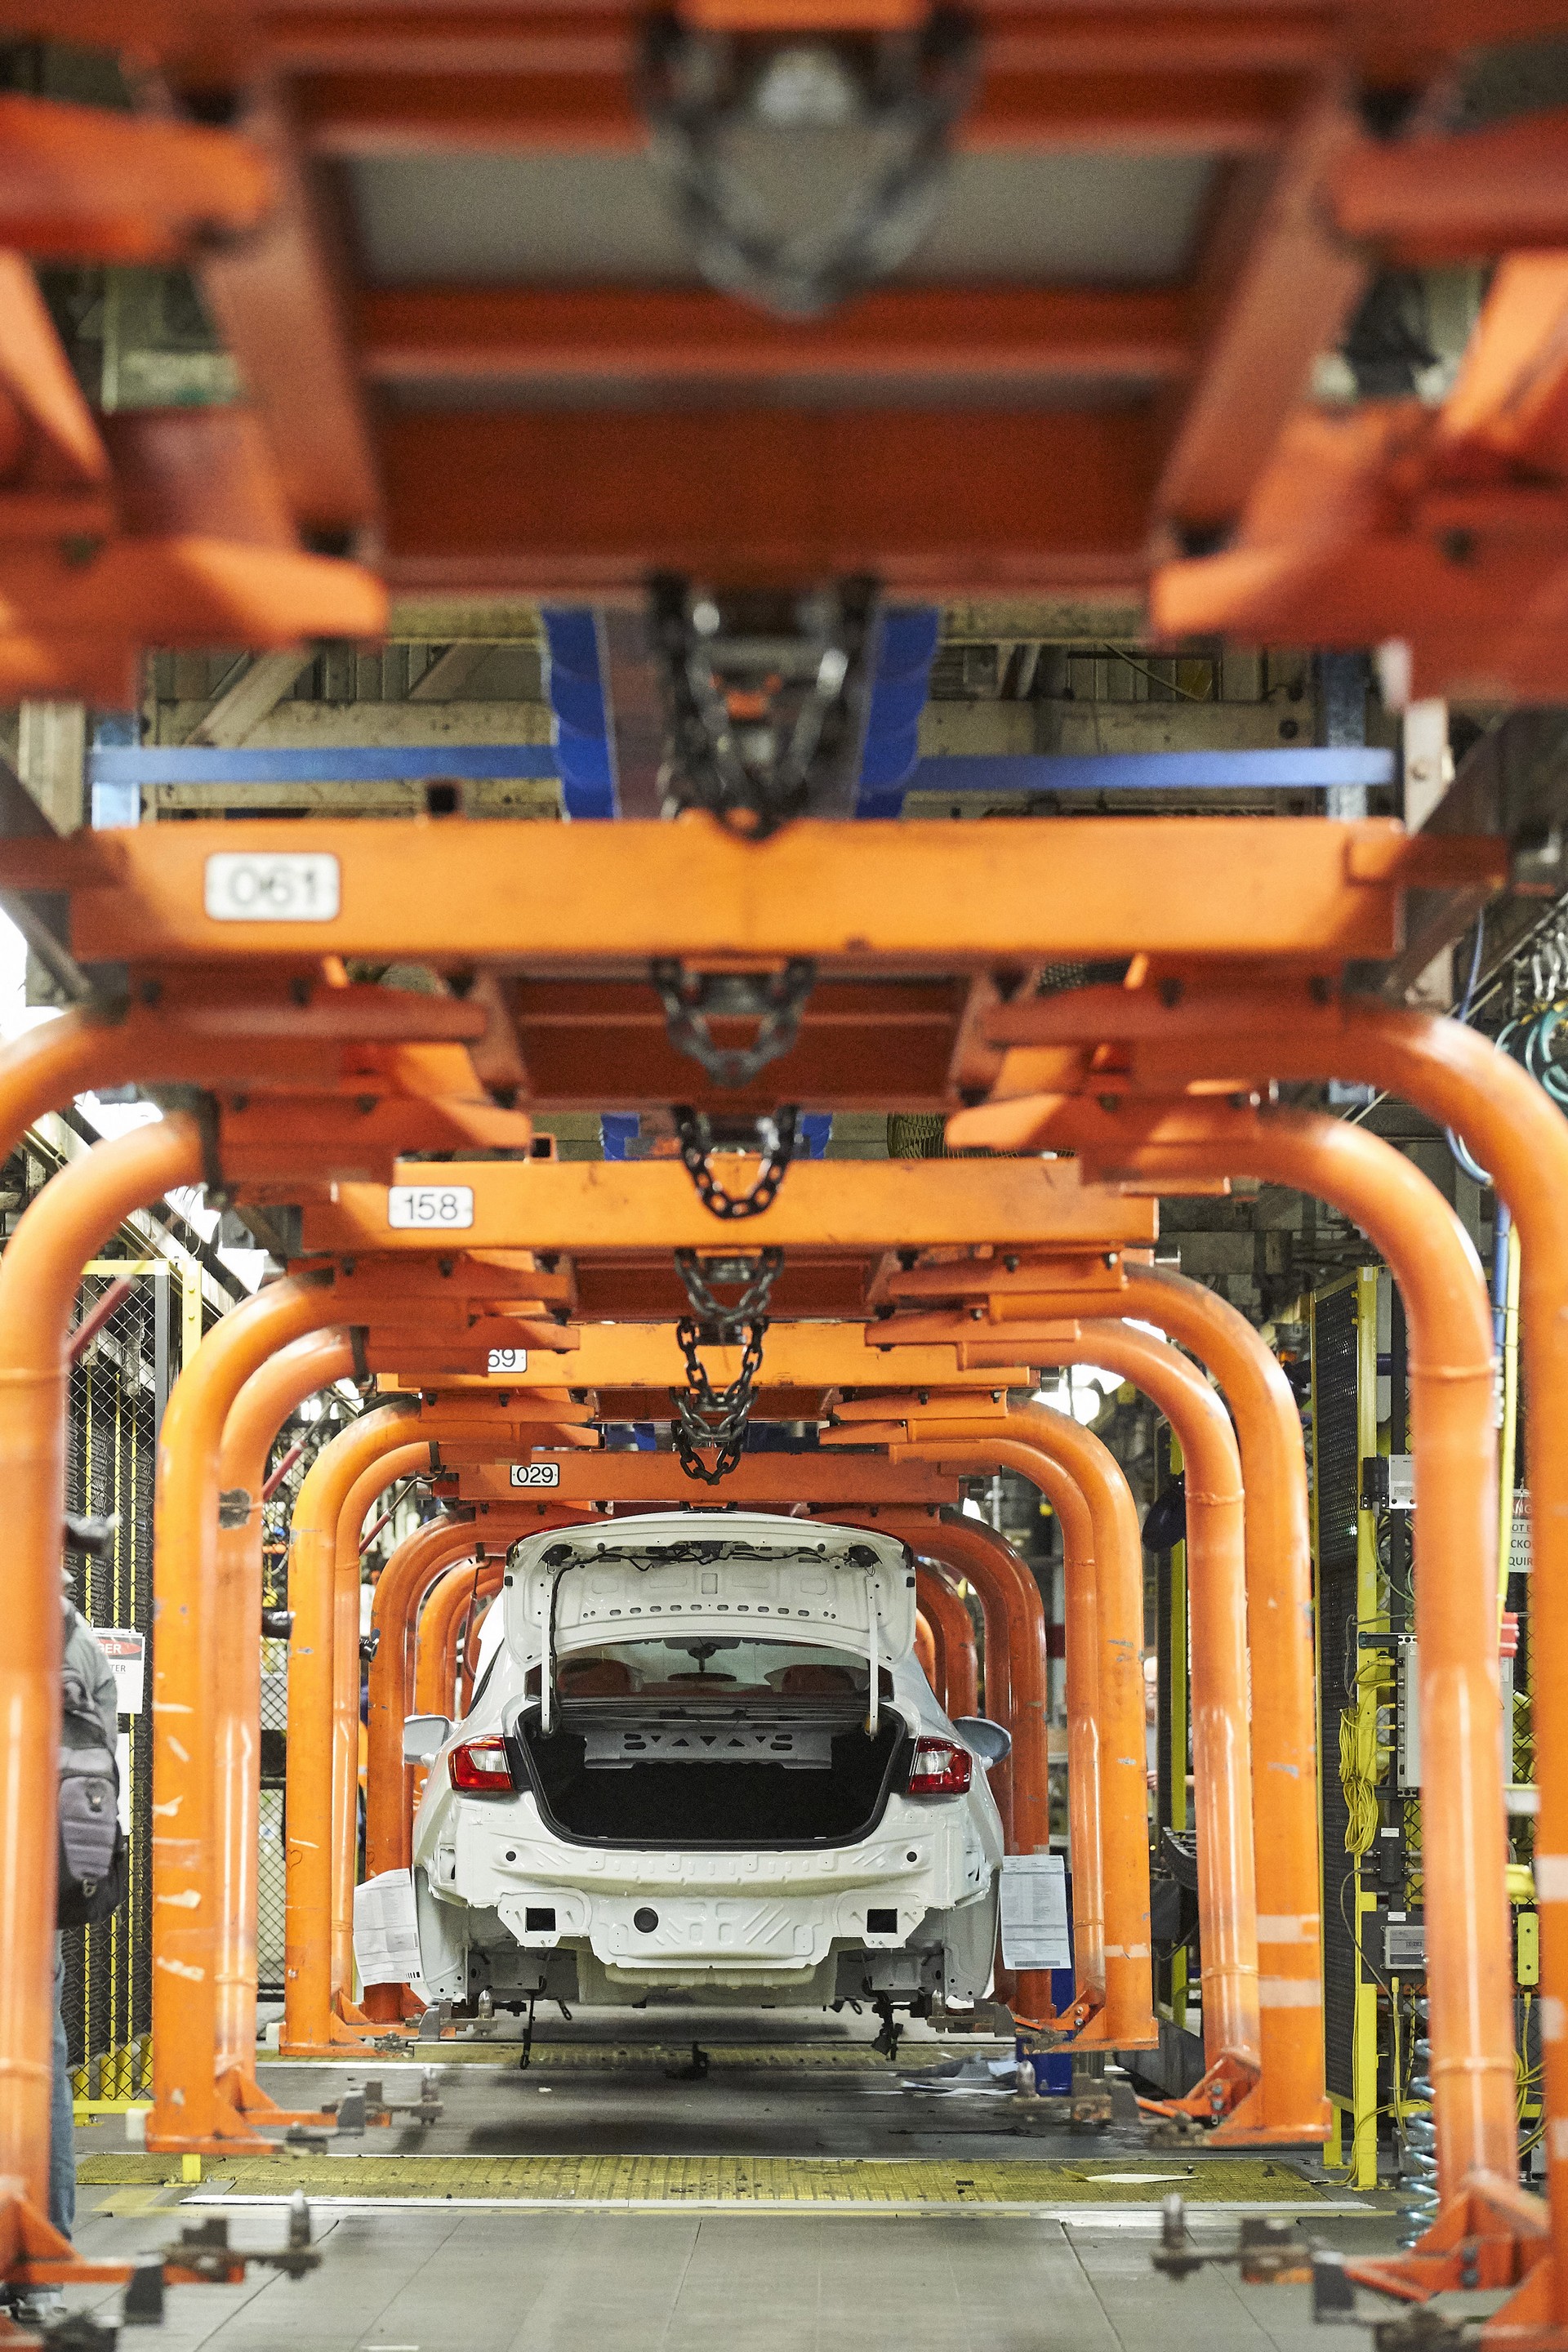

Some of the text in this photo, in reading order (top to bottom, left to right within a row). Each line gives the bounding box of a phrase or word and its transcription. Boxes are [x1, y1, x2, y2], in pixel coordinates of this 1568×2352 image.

[228, 865, 318, 906] 061
[404, 1193, 458, 1221] 158
[488, 1349, 516, 1368] 69
[516, 1466, 554, 1484] 029
[1512, 1524, 1525, 1532] OT
[1508, 1557, 1533, 1566] QUIR
